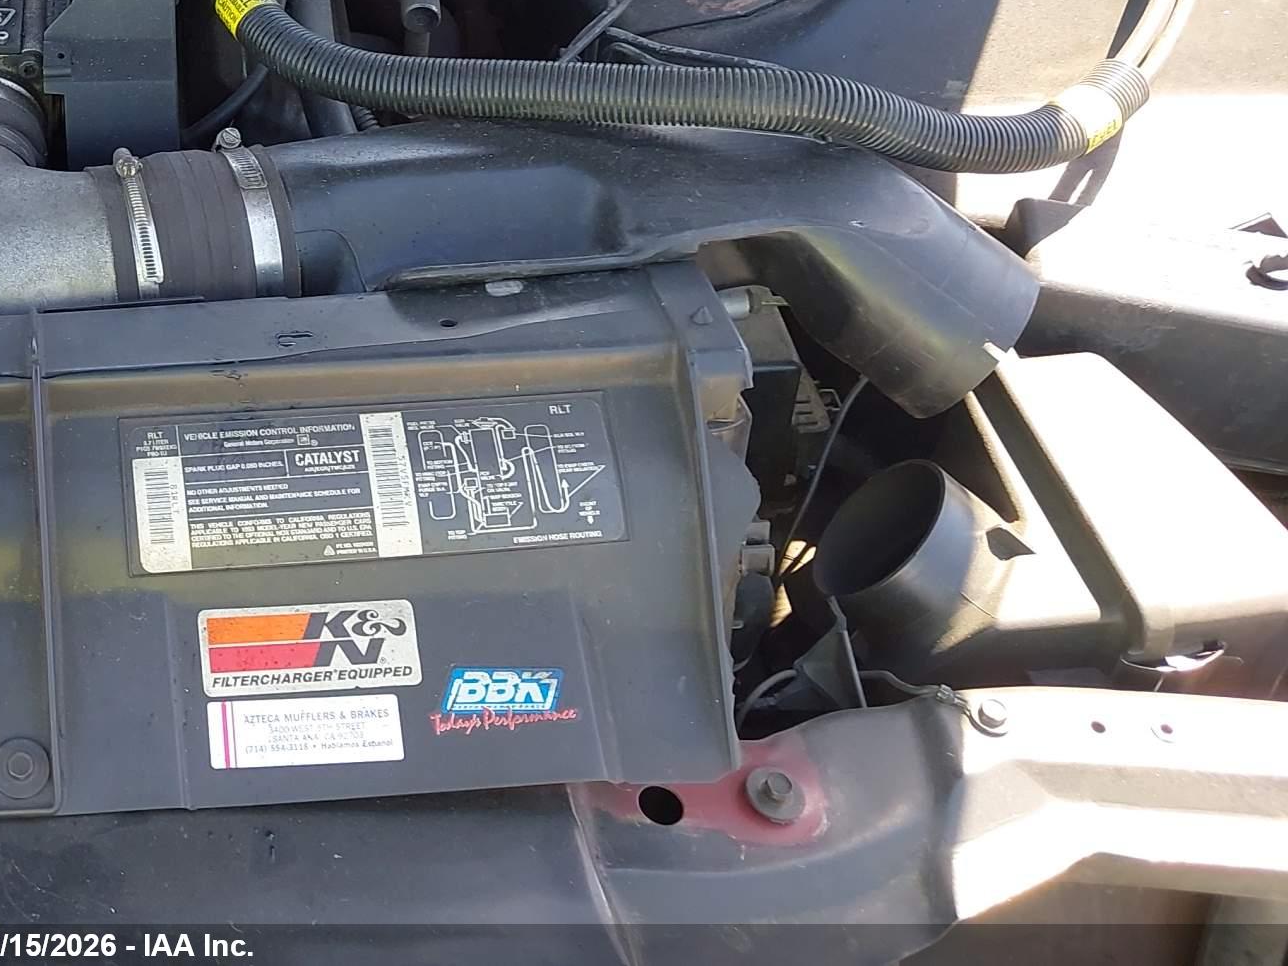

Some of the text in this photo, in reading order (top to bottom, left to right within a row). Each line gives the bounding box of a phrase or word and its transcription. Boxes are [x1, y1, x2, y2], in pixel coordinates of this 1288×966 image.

[549, 404, 570, 415] RLT
[220, 430, 258, 439] EMISSION
[259, 427, 297, 436] CONTROL
[295, 450, 360, 466] CATALYST
[212, 666, 412, 688] FILTERCHARGER EQUIPPED
[244, 713, 280, 724] AZTECA
[284, 711, 336, 722] MUFFLERS
[350, 708, 390, 720] BRAKES
[482, 706, 577, 731] Performance
